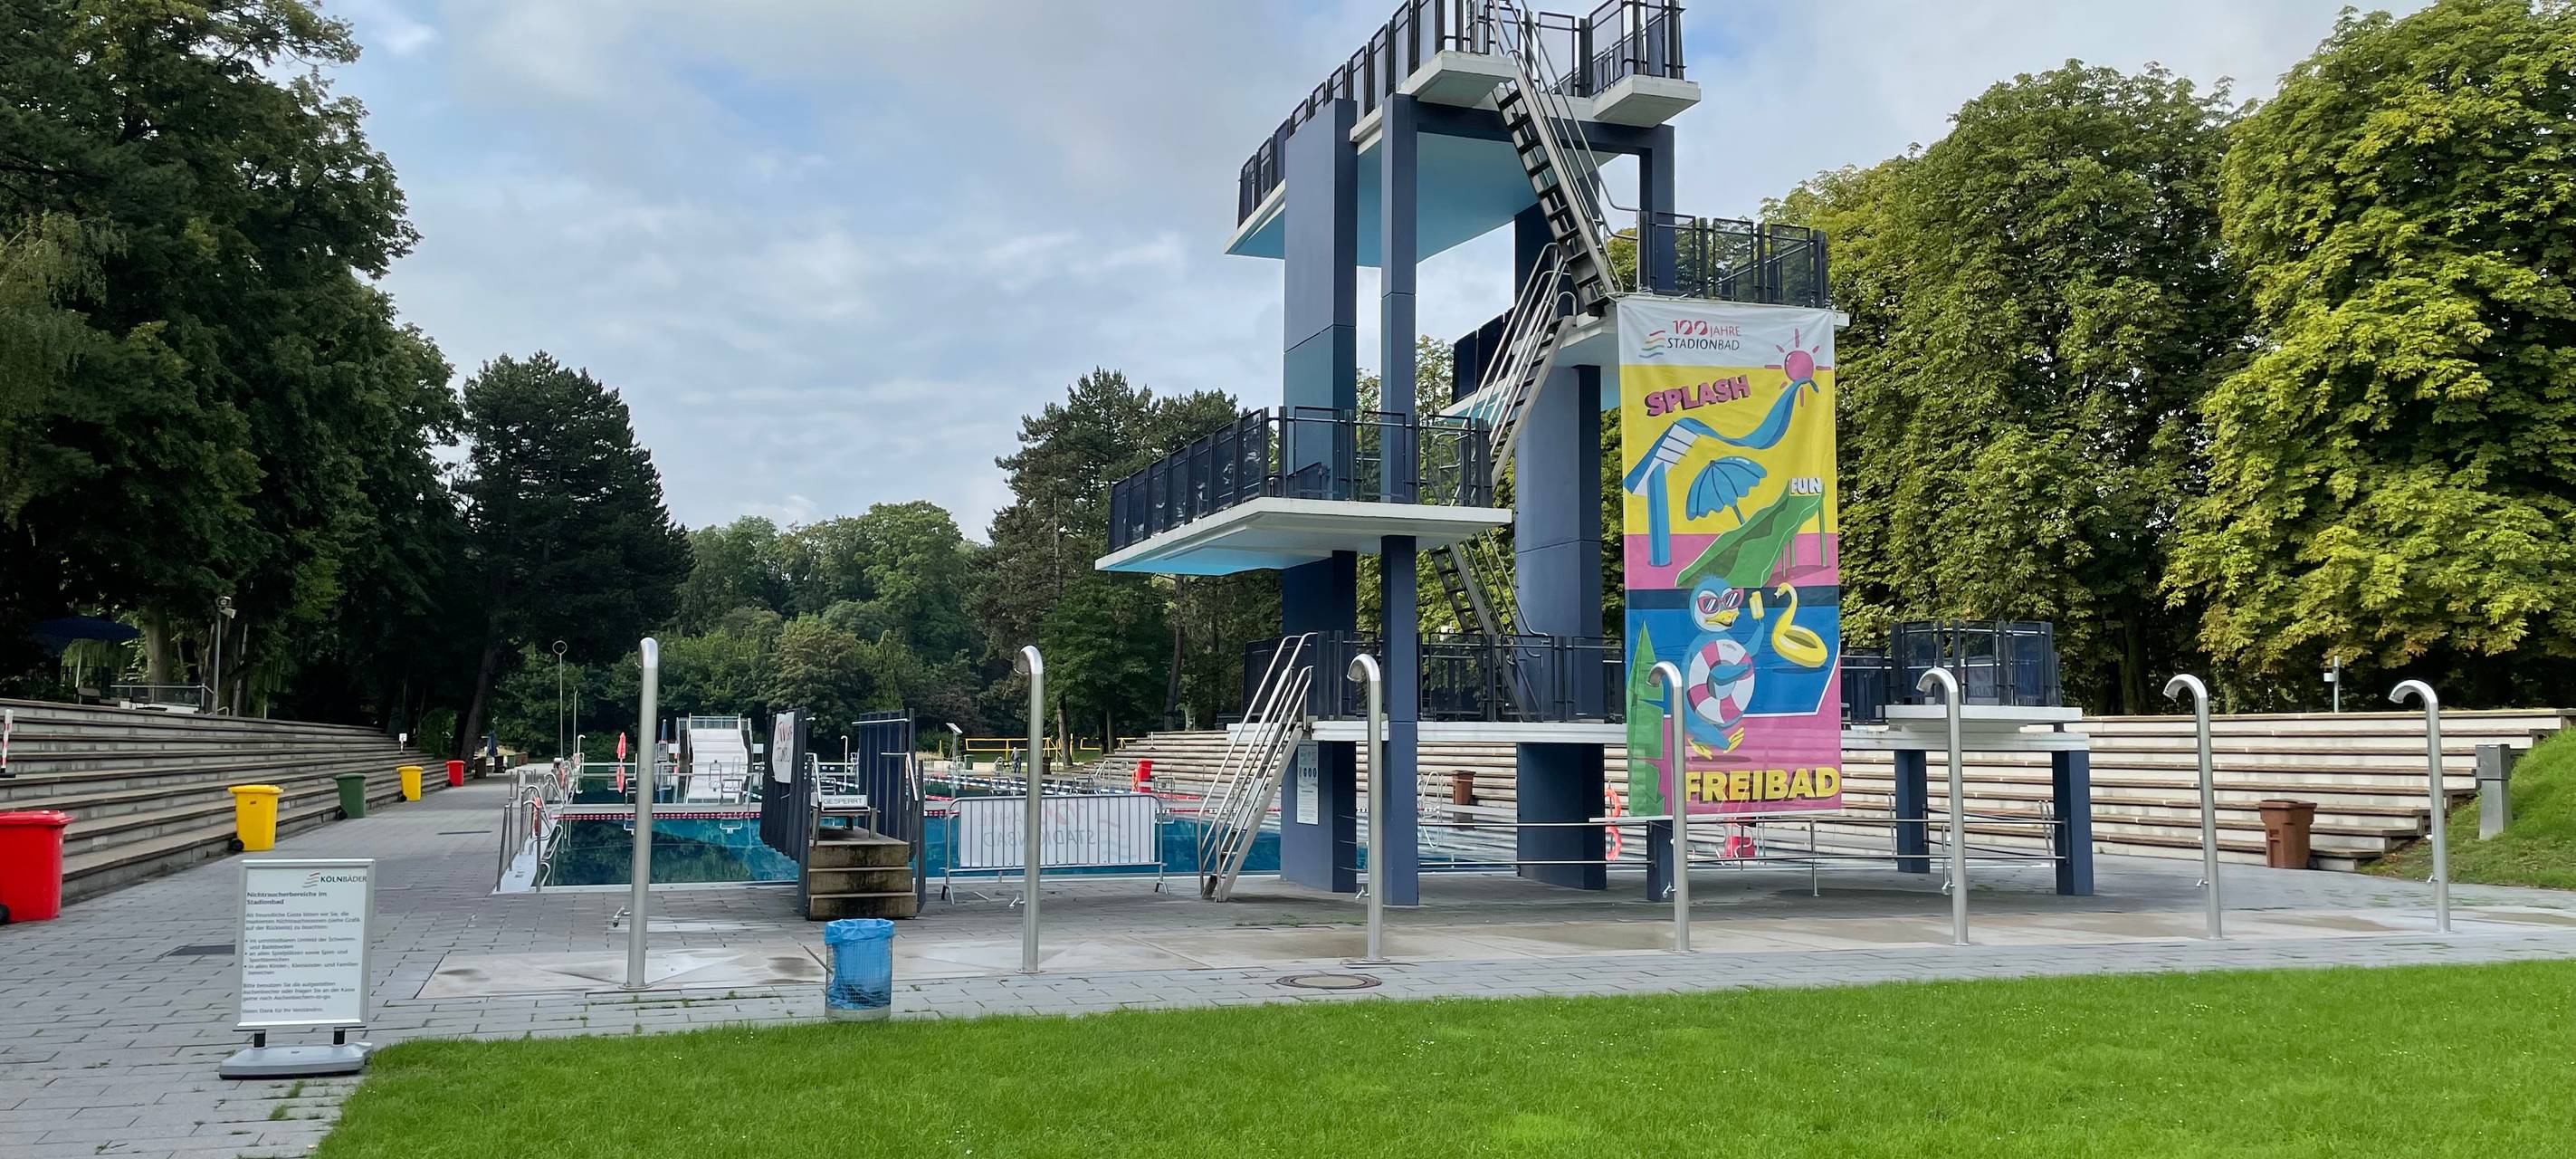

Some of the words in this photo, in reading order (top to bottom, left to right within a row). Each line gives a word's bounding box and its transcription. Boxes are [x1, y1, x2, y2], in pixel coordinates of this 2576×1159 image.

[1672, 320, 1709, 336] 100
[1710, 325, 1741, 338] JAHRE
[1666, 337, 1741, 351] STADIONBAD
[1645, 374, 1751, 417] SPLASH
[1789, 477, 1823, 495] FUN
[1684, 766, 1841, 804] FREIBAD
[823, 797, 863, 805] GESPERRT
[320, 875, 367, 883] KÖLNBÄDER
